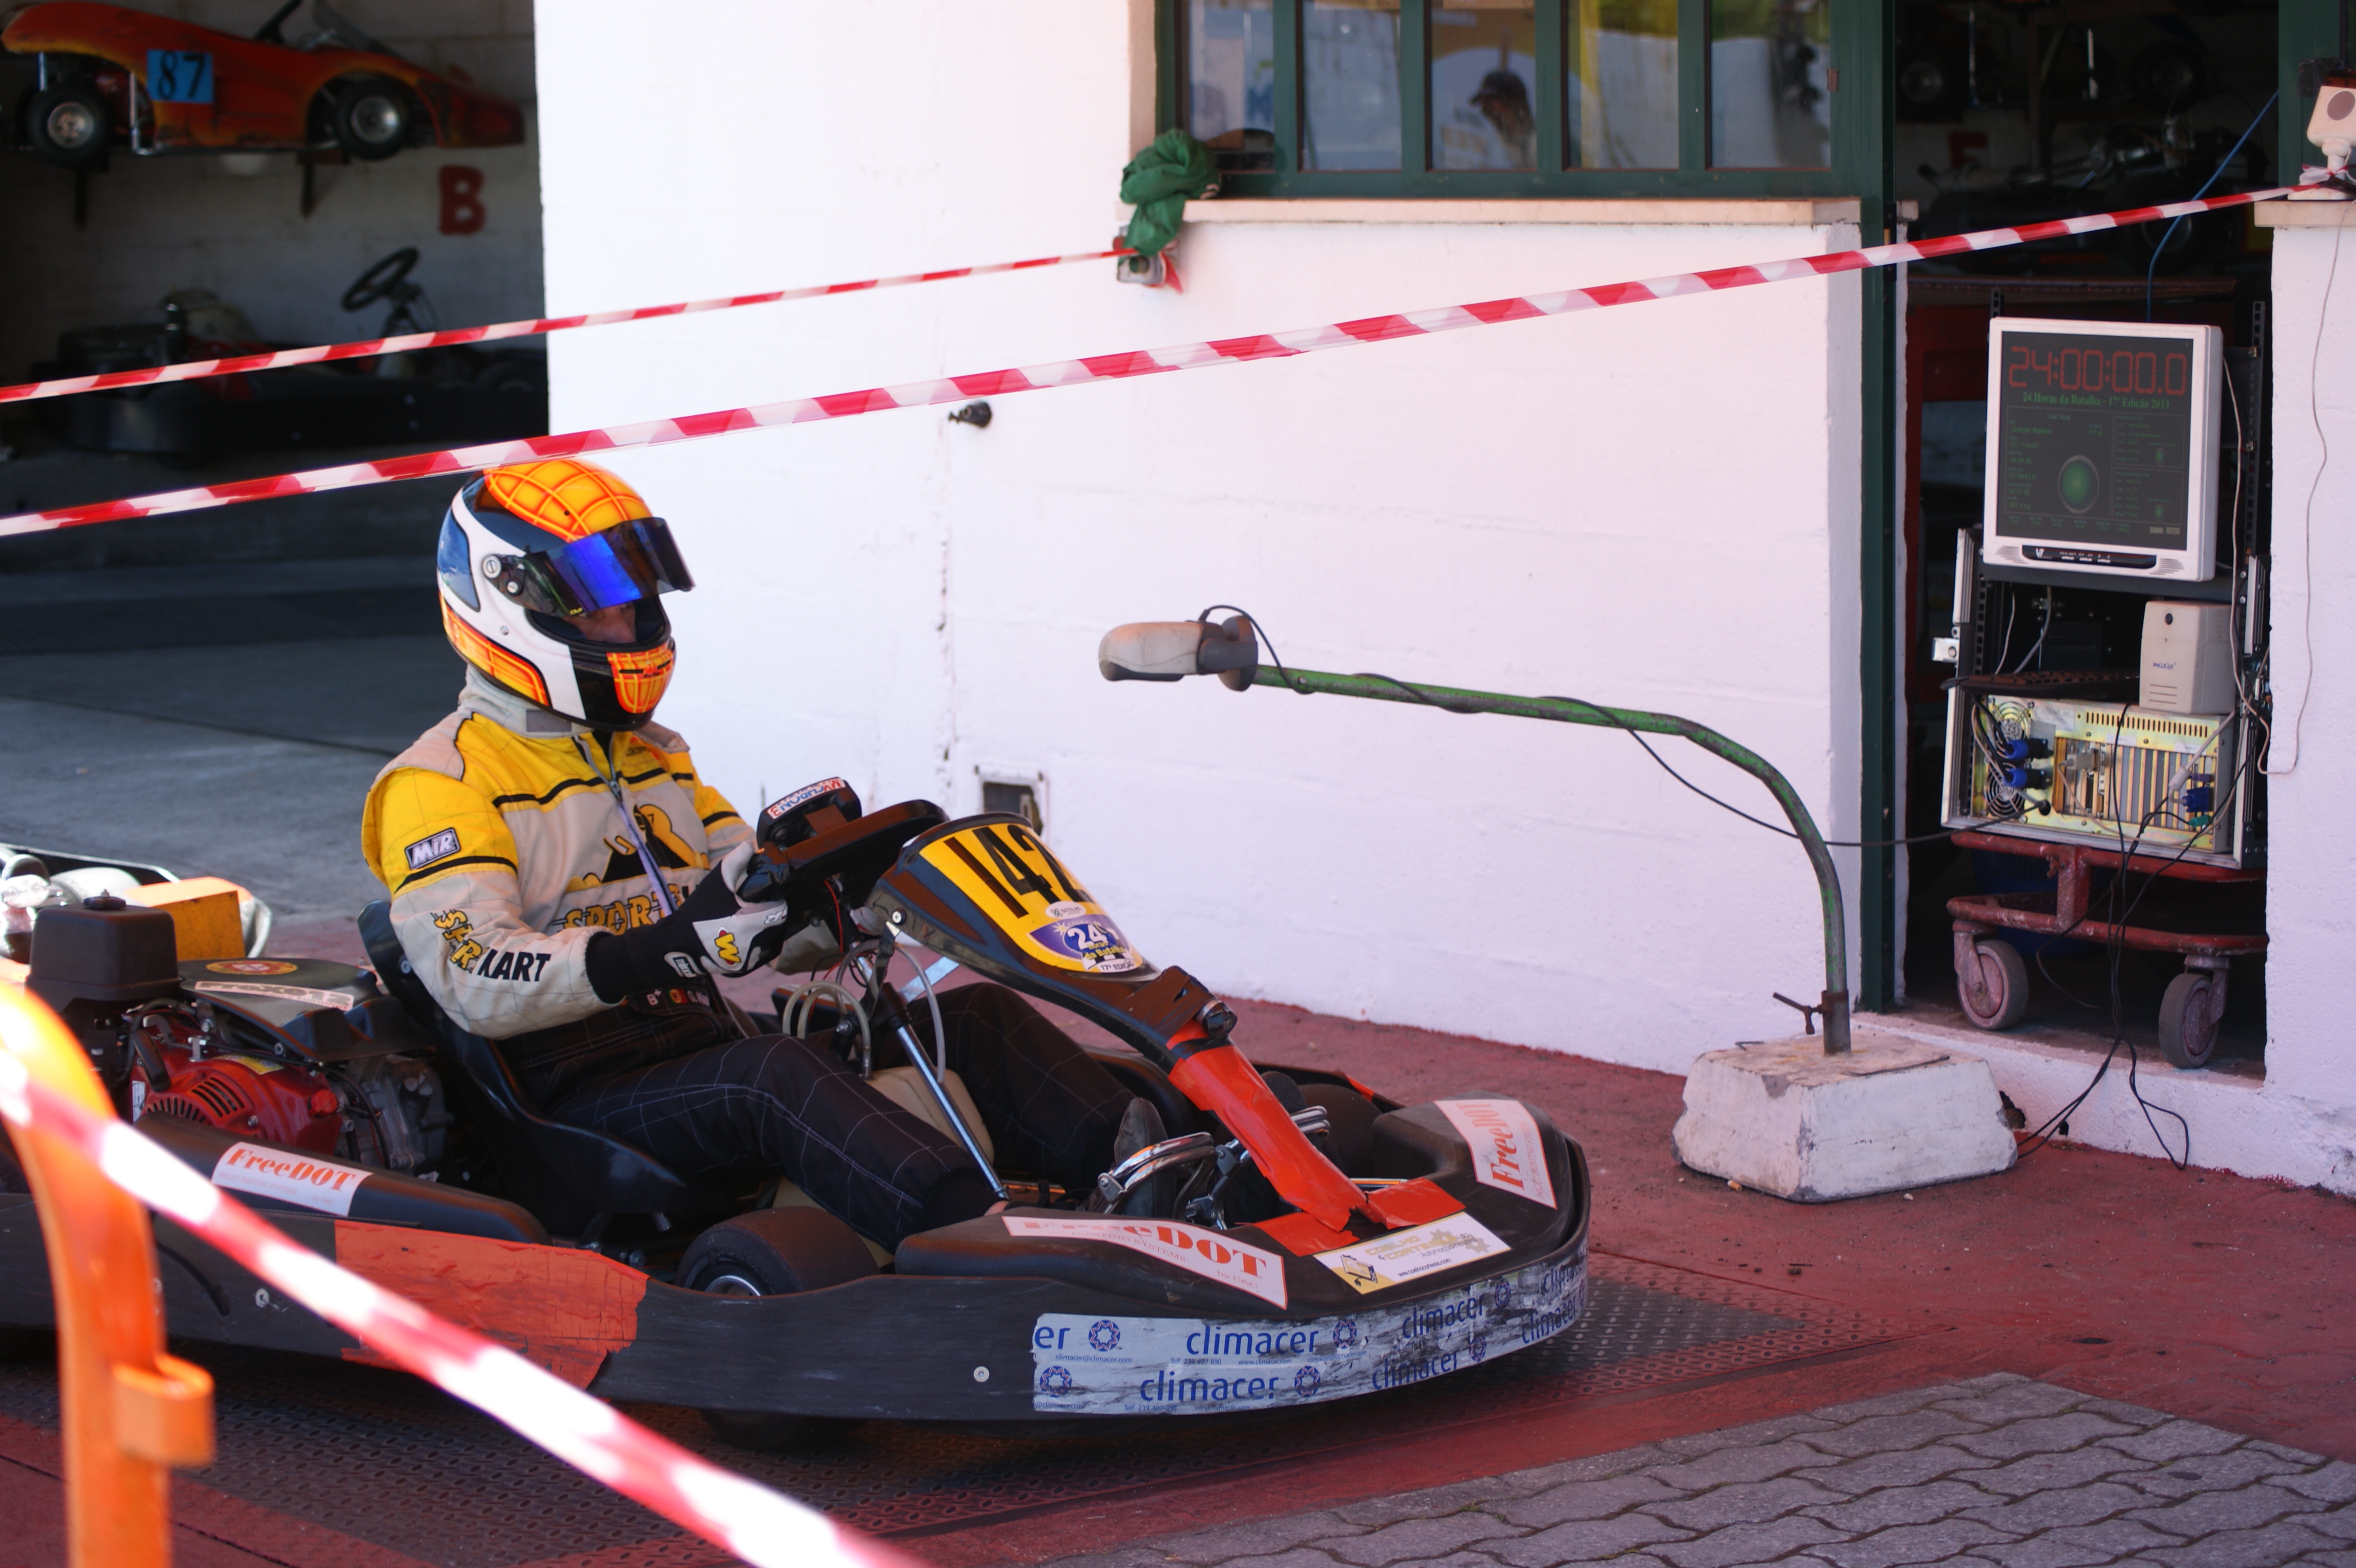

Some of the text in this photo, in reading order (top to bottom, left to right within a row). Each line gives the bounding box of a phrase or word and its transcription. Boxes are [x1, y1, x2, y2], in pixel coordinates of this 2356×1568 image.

[156, 50, 206, 101] 87
[438, 164, 486, 236] B
[2008, 345, 2188, 396] 24:00:00.0
[2023, 392, 2032, 402] 24
[2033, 393, 2058, 404] Horas
[2059, 394, 2069, 404] da
[2071, 395, 2102, 406] Batalha
[2122, 397, 2150, 410] Edição
[2151, 399, 2170, 409] 2013
[943, 824, 1095, 919] 142
[1067, 924, 1108, 950] 24
[1455, 1103, 1525, 1191] FreeDOT
[218, 1172, 297, 1196] INKJET PRINTING SYSTEMS
[226, 1148, 357, 1192] FreeDOT
[1133, 1238, 1187, 1263] SYSTEMS
[1217, 1269, 1229, 1278] by
[1402, 1292, 1486, 1340] climacer
[1186, 1325, 1319, 1355] climacer
[1055, 1354, 1132, 1363] climacer@climacer.com
[1371, 1352, 1458, 1390] climacer
[1140, 1370, 1279, 1402] climacer
